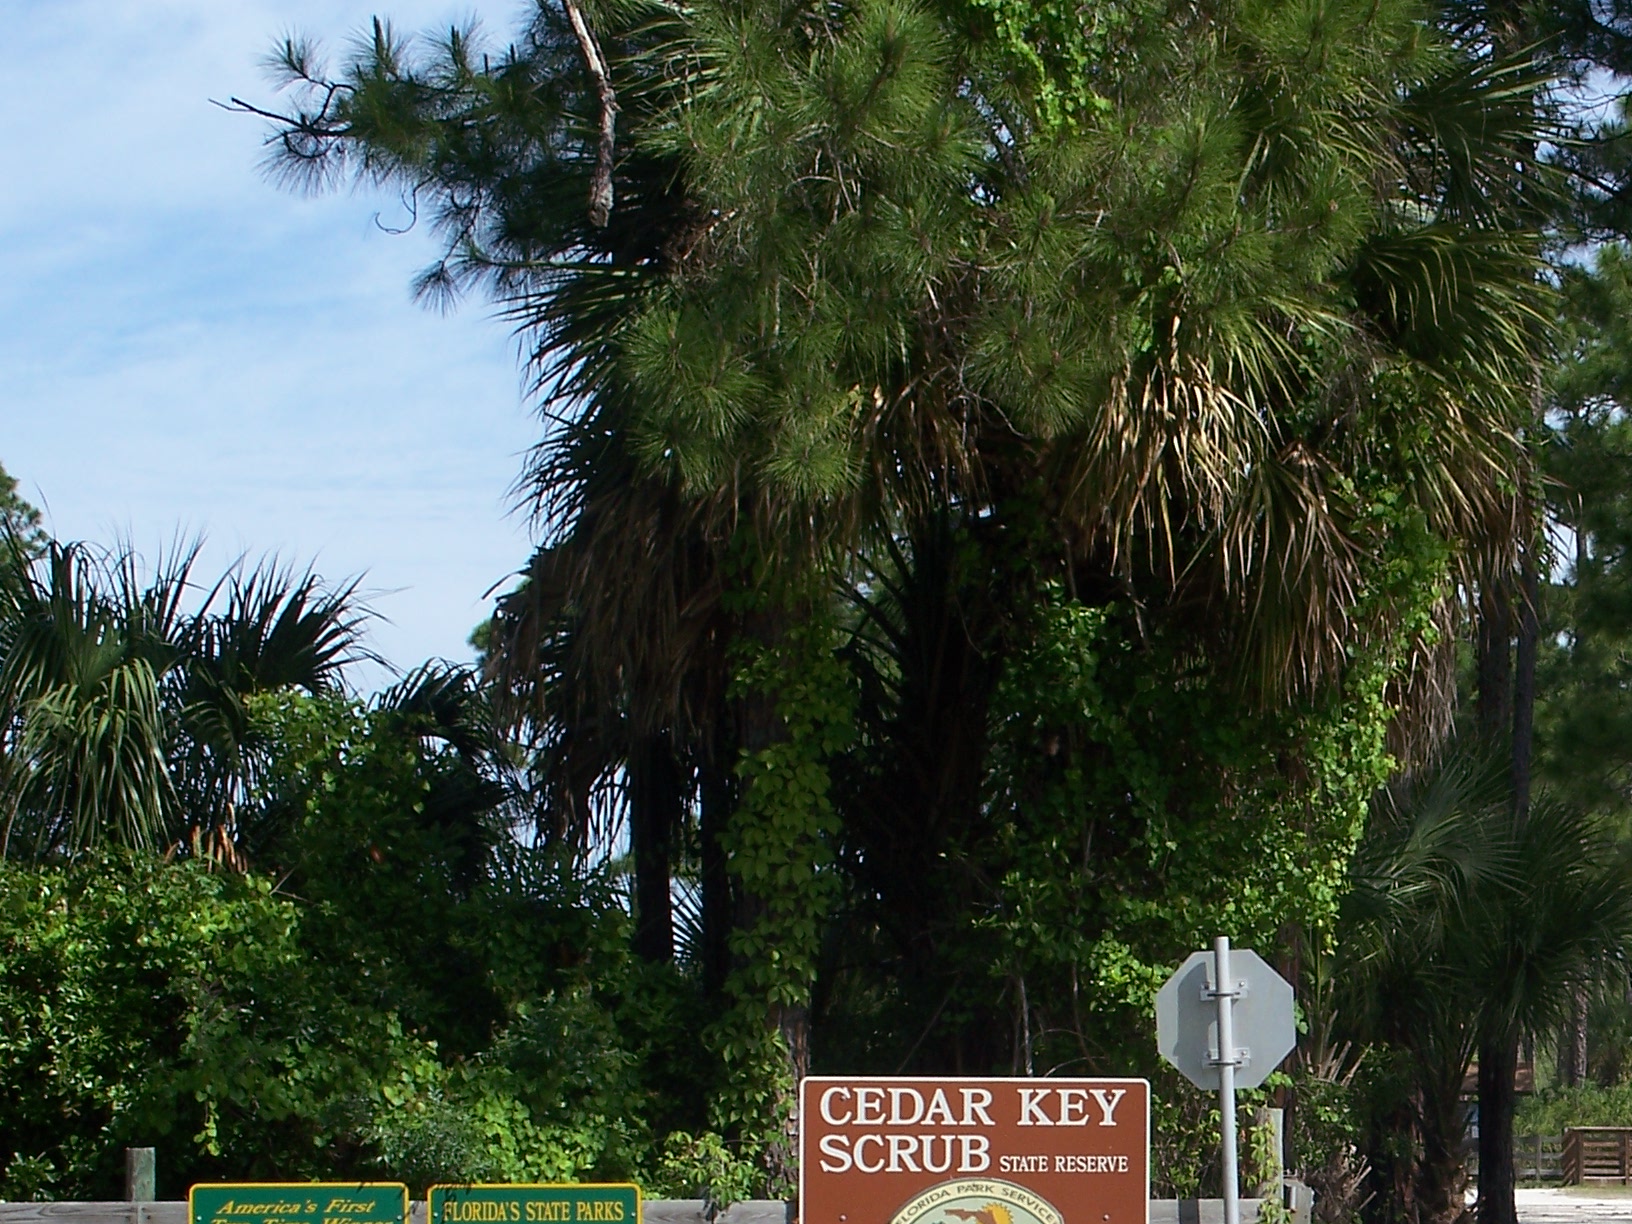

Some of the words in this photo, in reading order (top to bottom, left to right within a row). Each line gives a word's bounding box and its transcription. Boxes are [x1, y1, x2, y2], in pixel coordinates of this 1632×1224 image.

[819, 1086, 996, 1127] CEDAR
[1016, 1087, 1127, 1127] KEY
[818, 1133, 991, 1173] SCRUB
[999, 1155, 1049, 1173] STATE
[1054, 1155, 1129, 1173] RESERVE
[215, 1199, 318, 1215] America's
[323, 1198, 376, 1214] First
[443, 1201, 521, 1222] FLORIDA'S
[525, 1201, 570, 1221] STATE
[575, 1201, 625, 1221] PARKS
[957, 1183, 996, 1195] PARK
[1001, 1187, 1056, 1222] SERVICE
